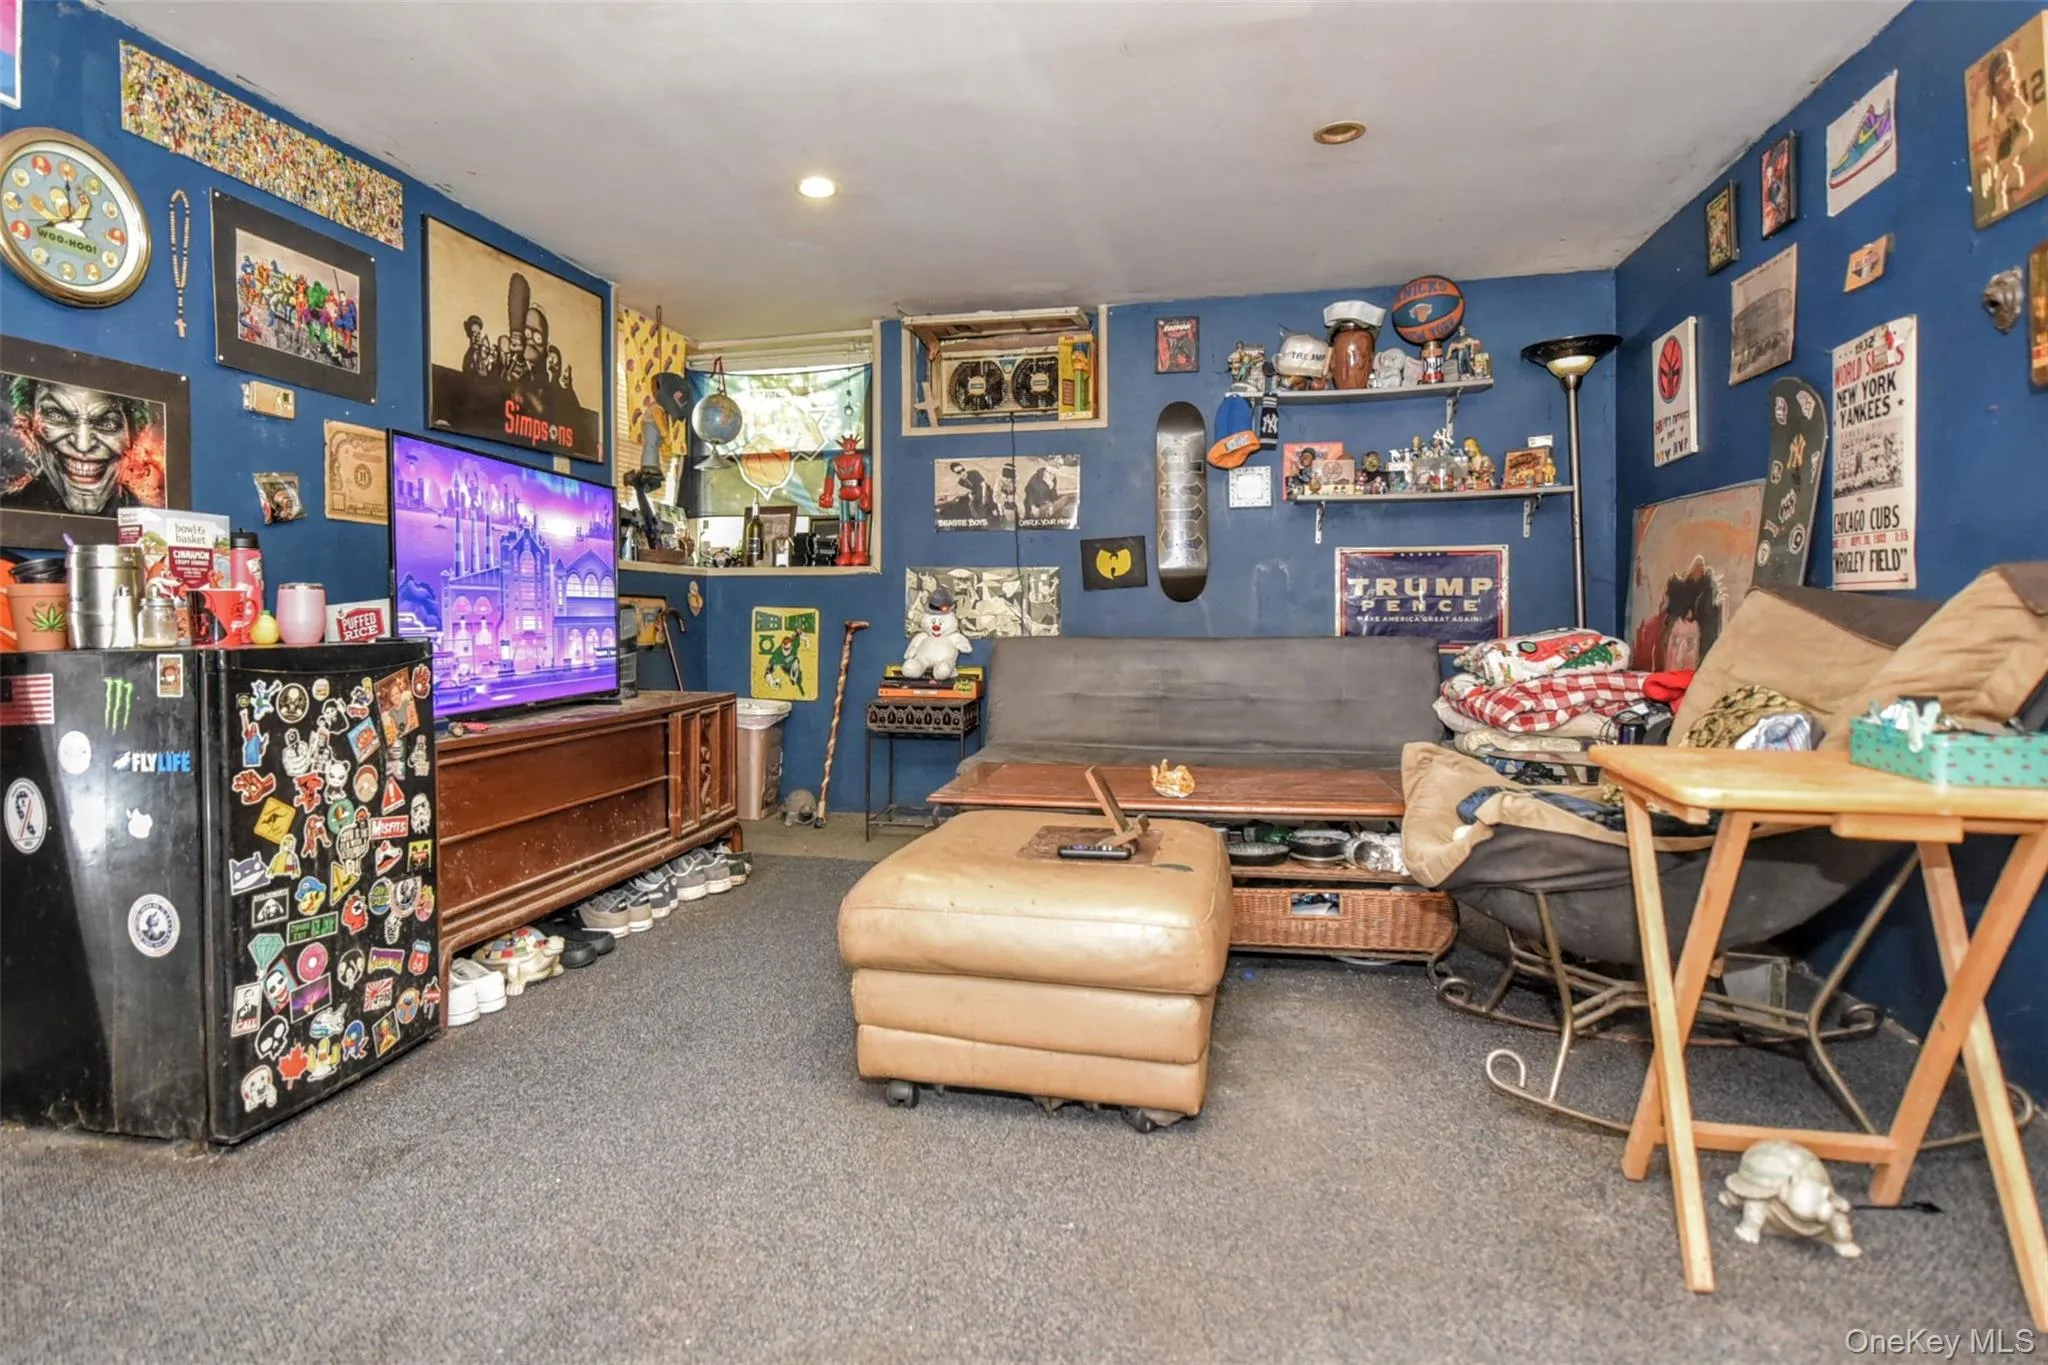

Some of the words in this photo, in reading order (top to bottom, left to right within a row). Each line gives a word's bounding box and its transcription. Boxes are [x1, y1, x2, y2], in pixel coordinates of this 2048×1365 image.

[39, 230, 97, 255] WOO-HOO!
[1855, 336, 1875, 354] 1932
[1835, 357, 1861, 388] WORLD
[1836, 386, 1857, 410] NEW
[1861, 371, 1896, 400] YORK
[1840, 395, 1890, 428] YANKEES
[505, 400, 573, 447] Simpsons
[968, 518, 988, 527] BOYS
[1834, 509, 1865, 534] CHICAGO
[1870, 504, 1900, 530] CUBS
[175, 523, 196, 534] bowl
[175, 534, 206, 545] basket
[173, 550, 210, 560] CINNAMON
[1347, 577, 1493, 597] TRUMP
[1361, 600, 1479, 612] PENCE
[342, 612, 377, 631] PUFFED
[1357, 615, 1380, 623] MAKE
[1383, 615, 1420, 623] AMERICA
[1422, 614, 1449, 623] GREAT
[344, 625, 379, 641] RICE
[371, 820, 406, 837] MISFITS
